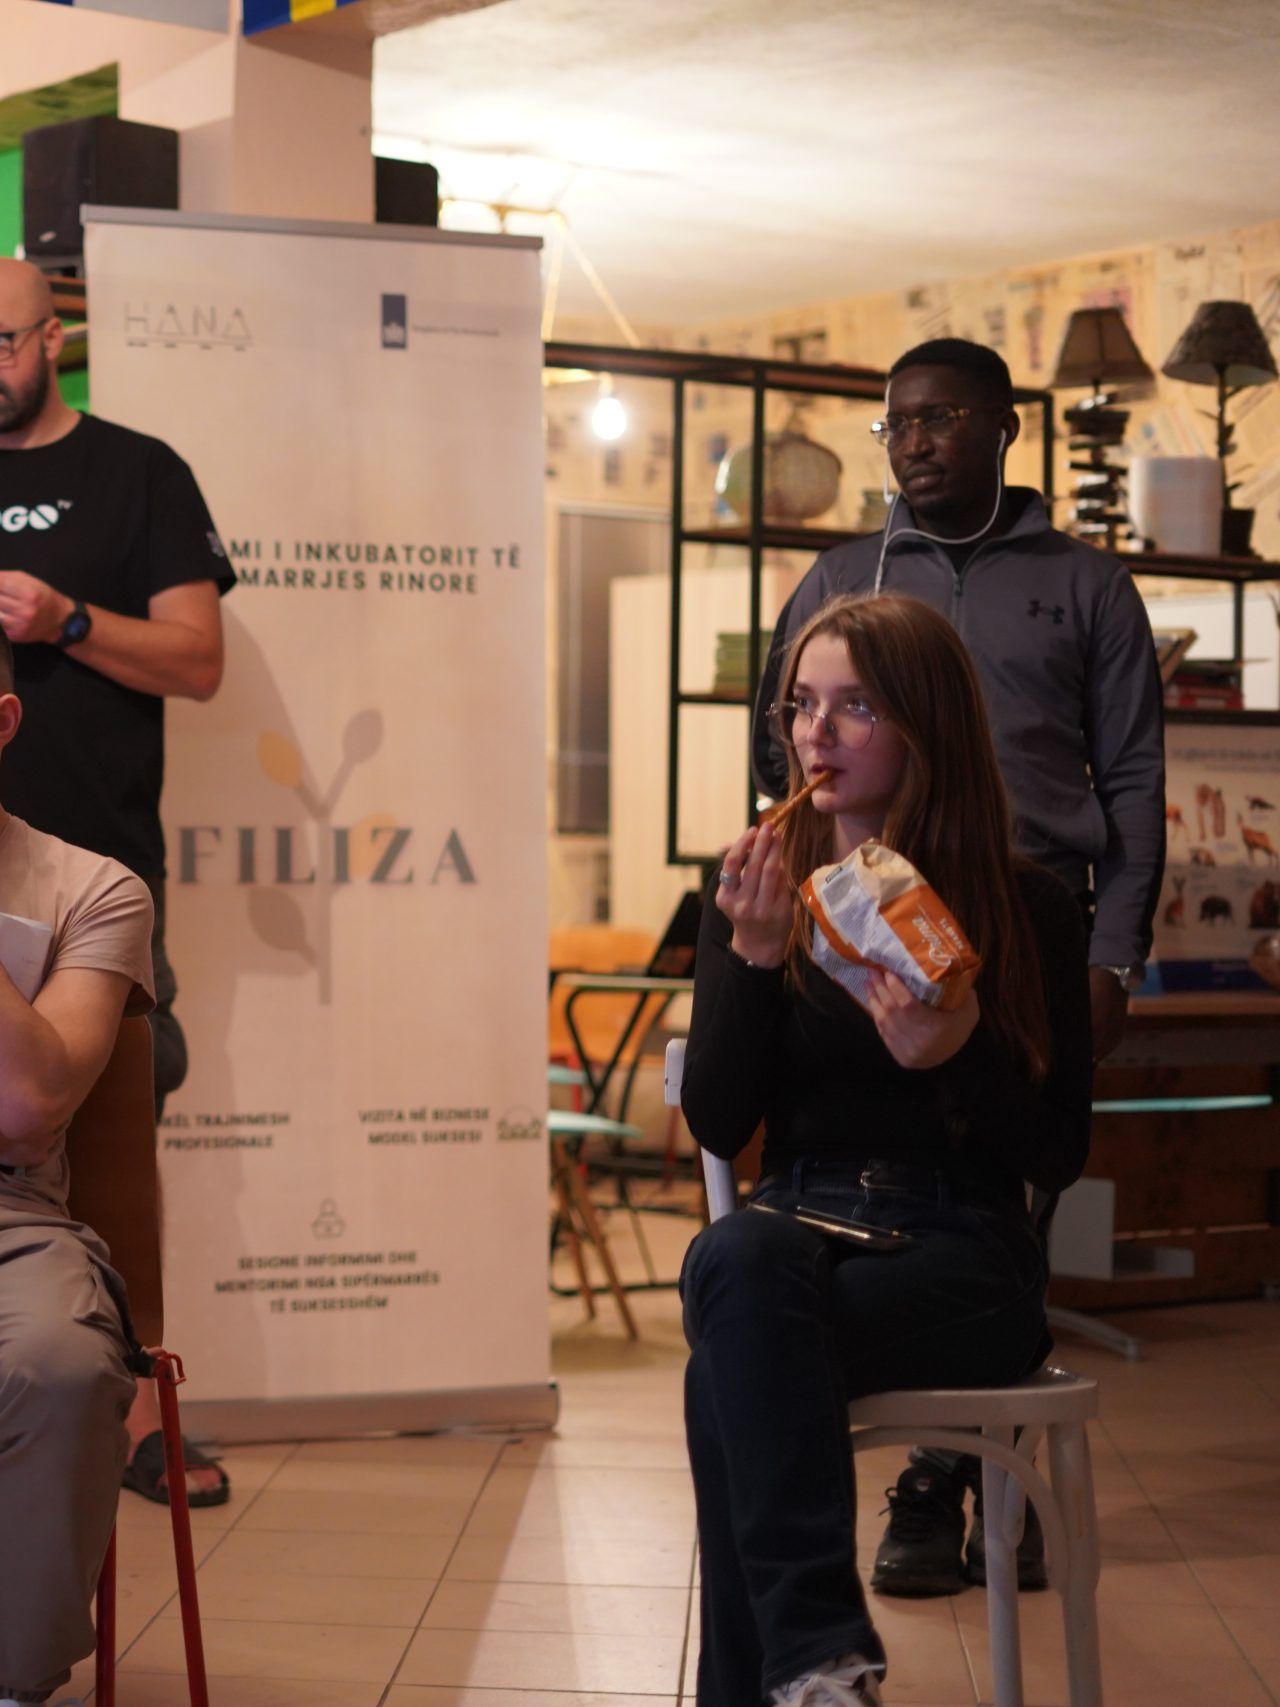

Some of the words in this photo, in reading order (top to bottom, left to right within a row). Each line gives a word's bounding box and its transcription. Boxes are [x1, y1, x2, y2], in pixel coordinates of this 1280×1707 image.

[274, 541, 282, 561] I
[294, 541, 478, 567] INKUBATORIT
[239, 567, 366, 590] MARRJES
[379, 571, 478, 595] RINORE
[176, 826, 479, 886] FILIZA
